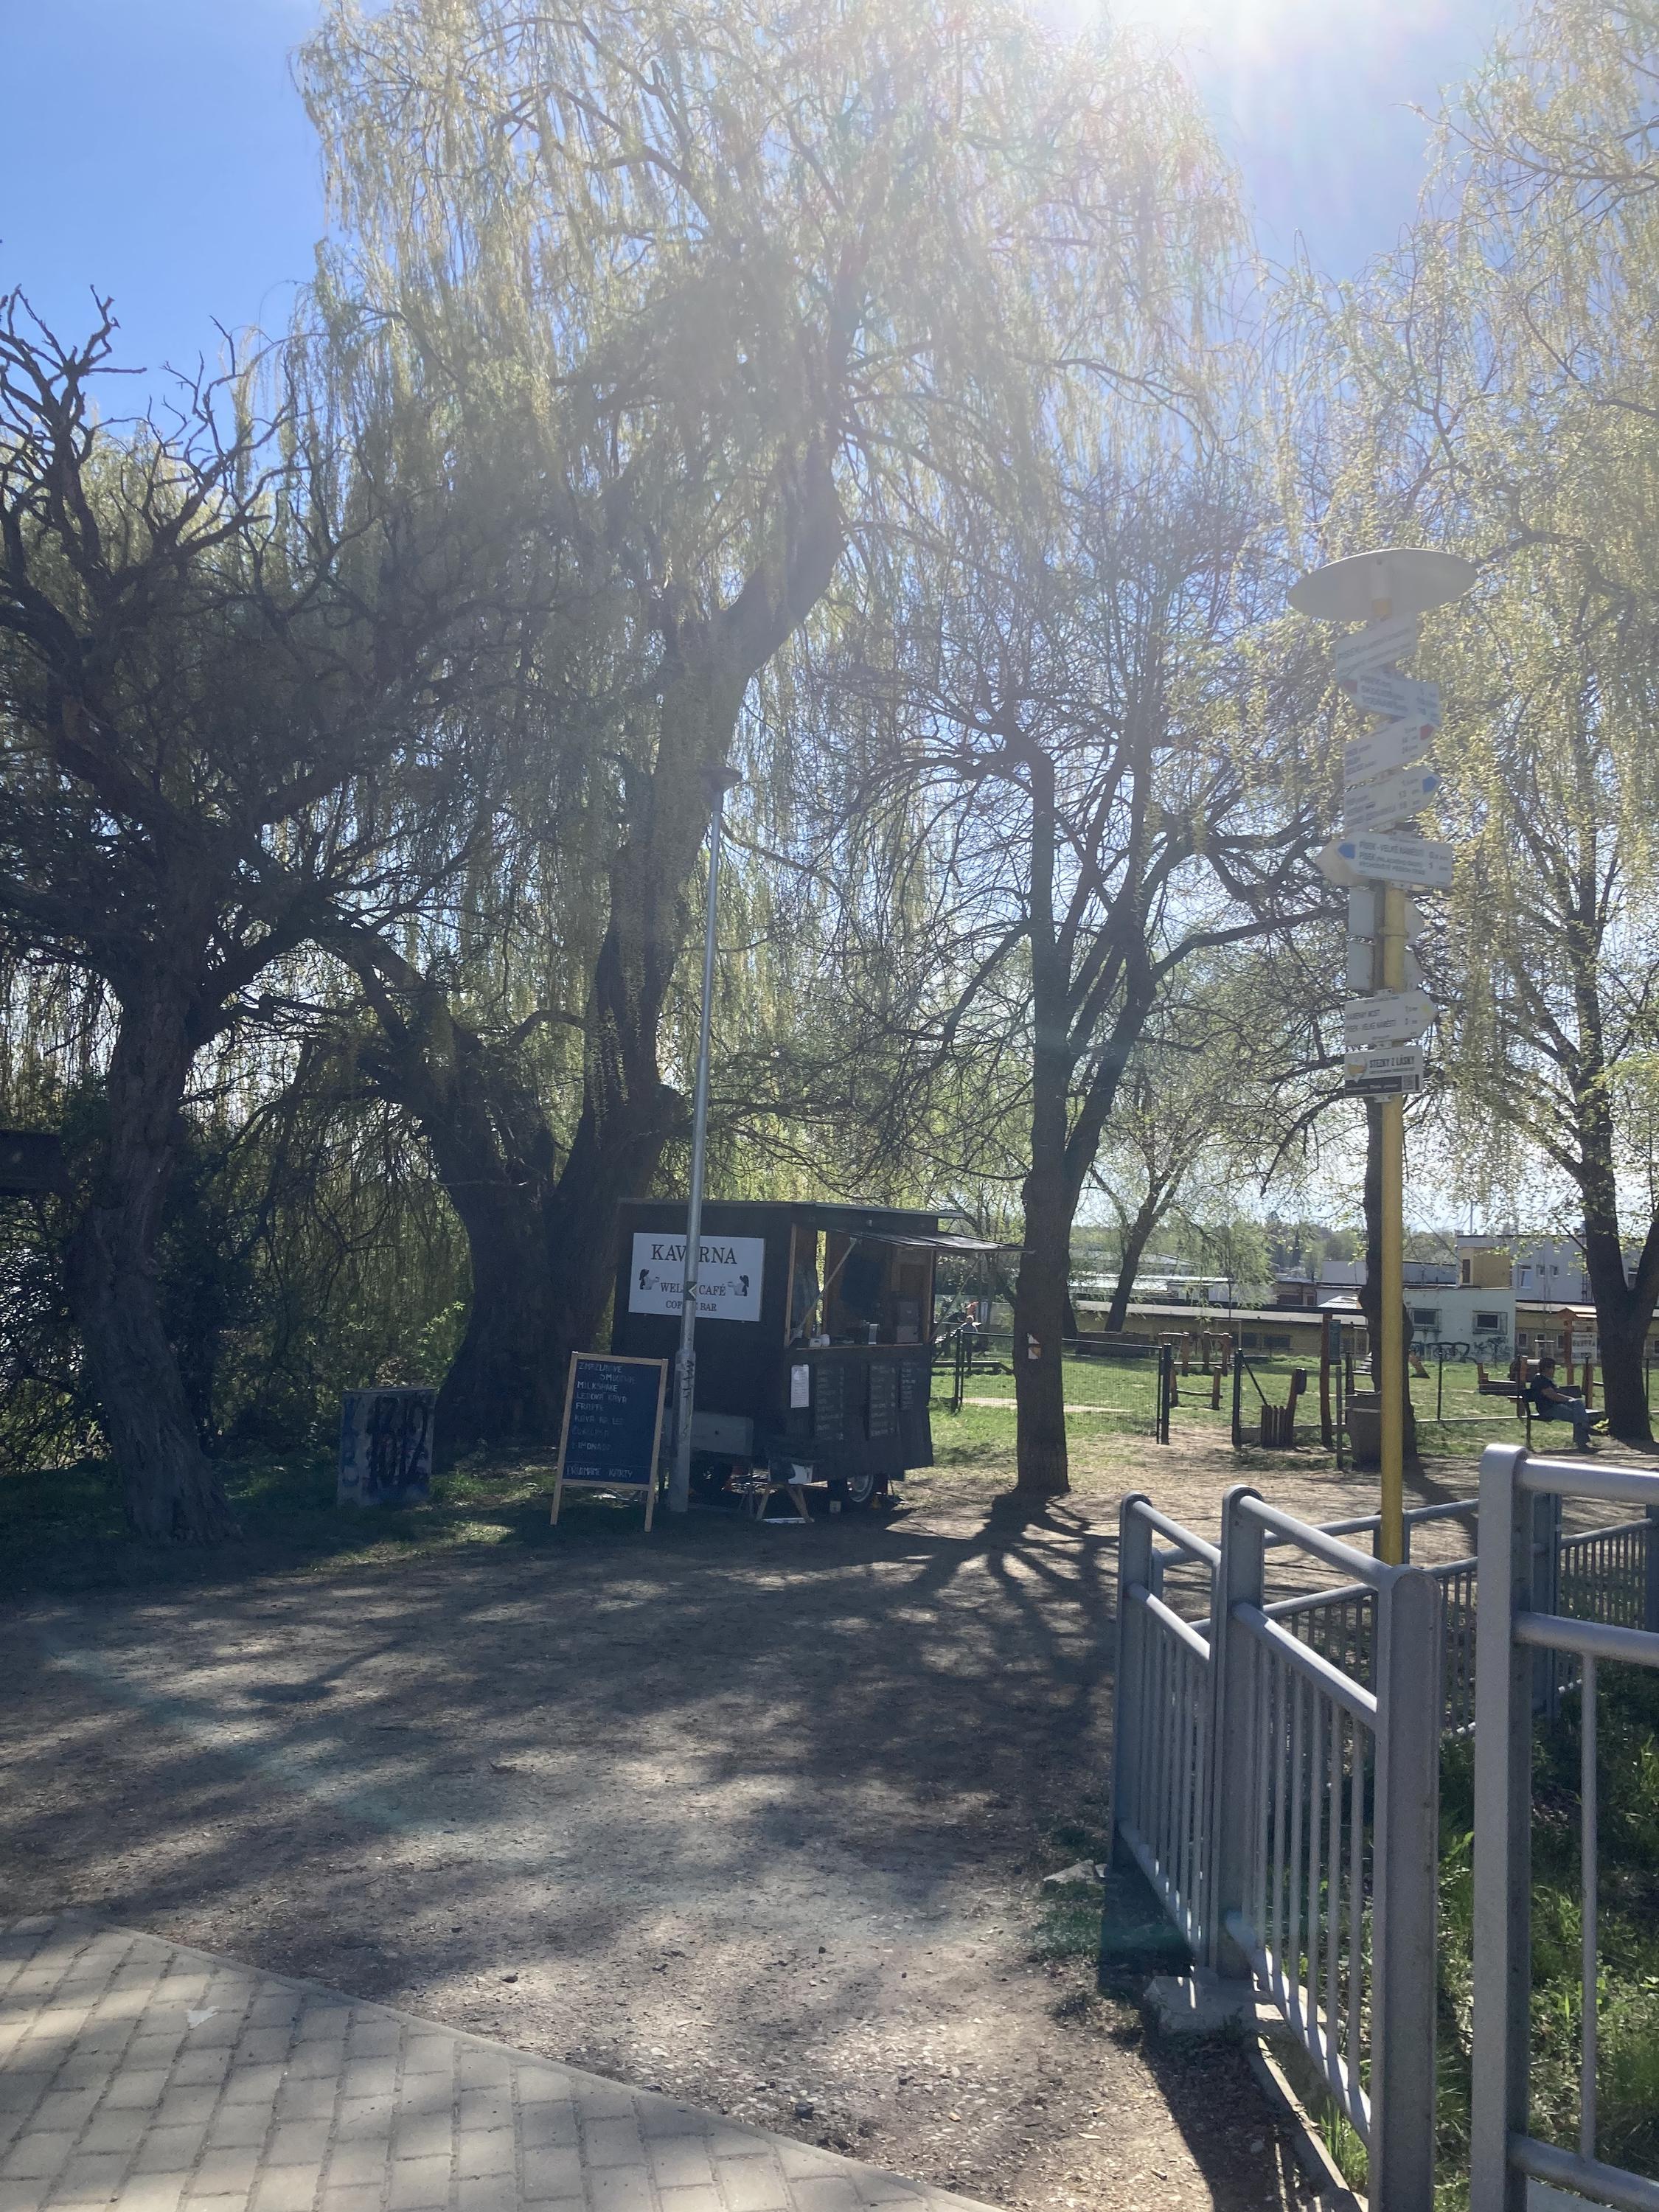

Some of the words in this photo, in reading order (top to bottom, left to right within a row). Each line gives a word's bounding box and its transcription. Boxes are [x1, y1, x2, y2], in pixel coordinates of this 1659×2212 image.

[650, 1244, 737, 1265] KAVRNA
[661, 1282, 692, 1294] WEL
[698, 1283, 726, 1296] CAFÉ
[666, 1300, 698, 1310] COF
[700, 1302, 717, 1312] BAR
